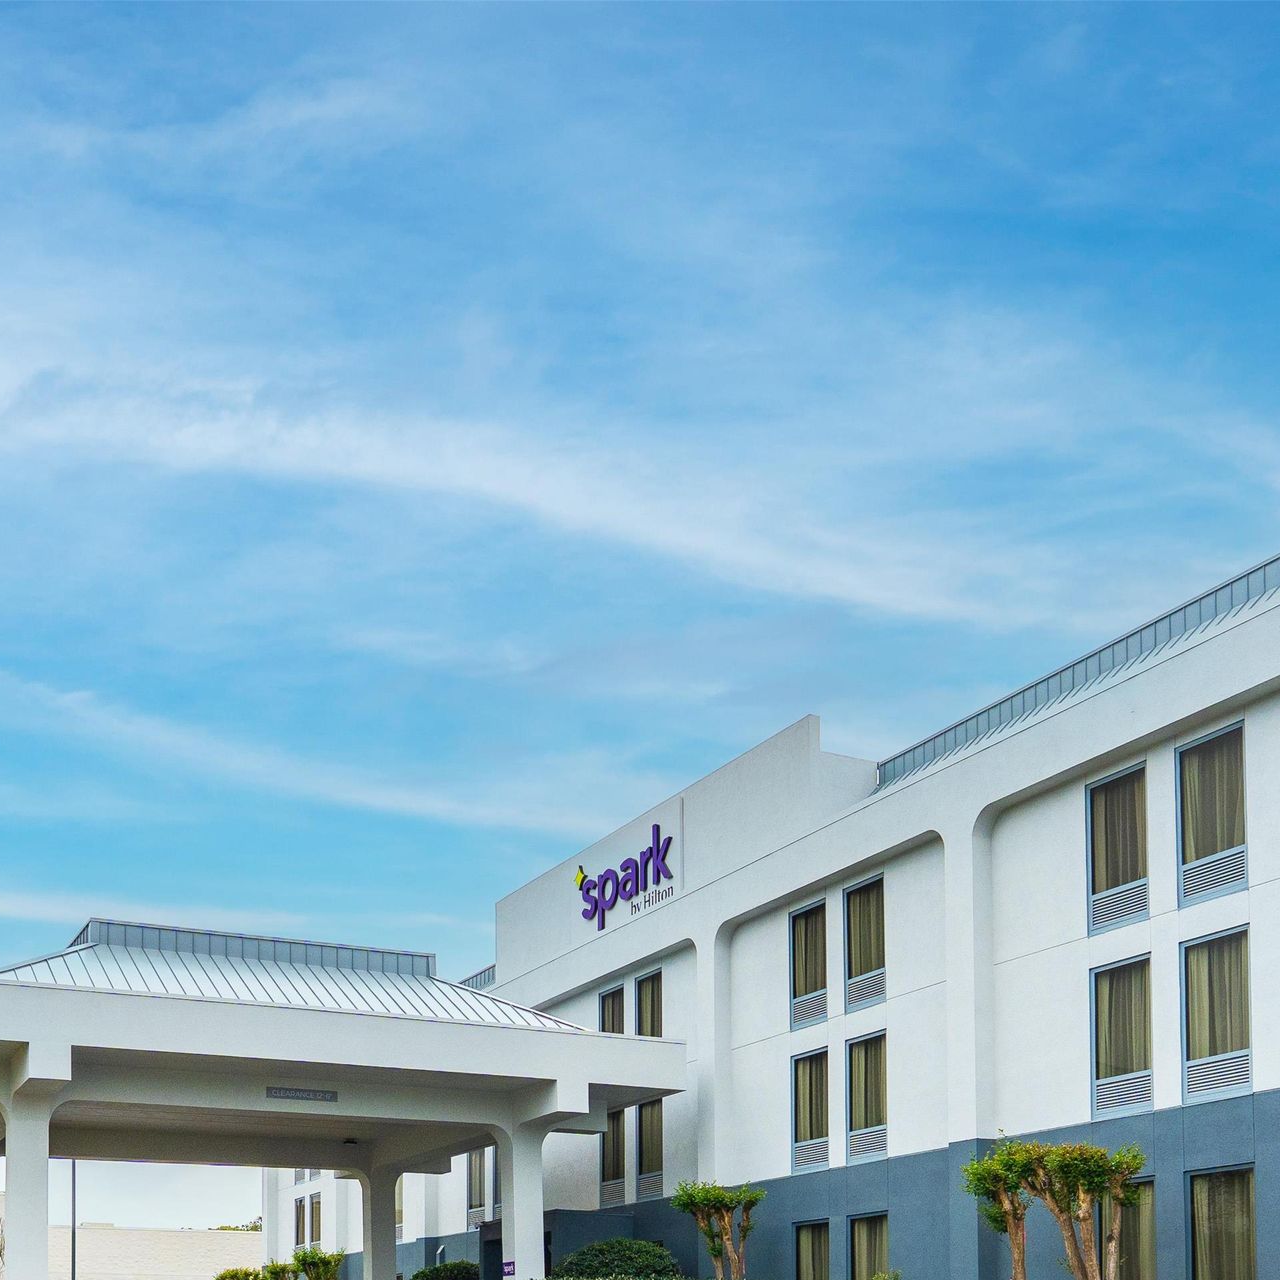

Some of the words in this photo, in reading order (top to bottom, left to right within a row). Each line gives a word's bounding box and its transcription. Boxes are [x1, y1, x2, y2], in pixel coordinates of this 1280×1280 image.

[581, 823, 674, 932] spark
[643, 885, 674, 910] Hilton
[271, 1089, 315, 1099] CLEARANCE
